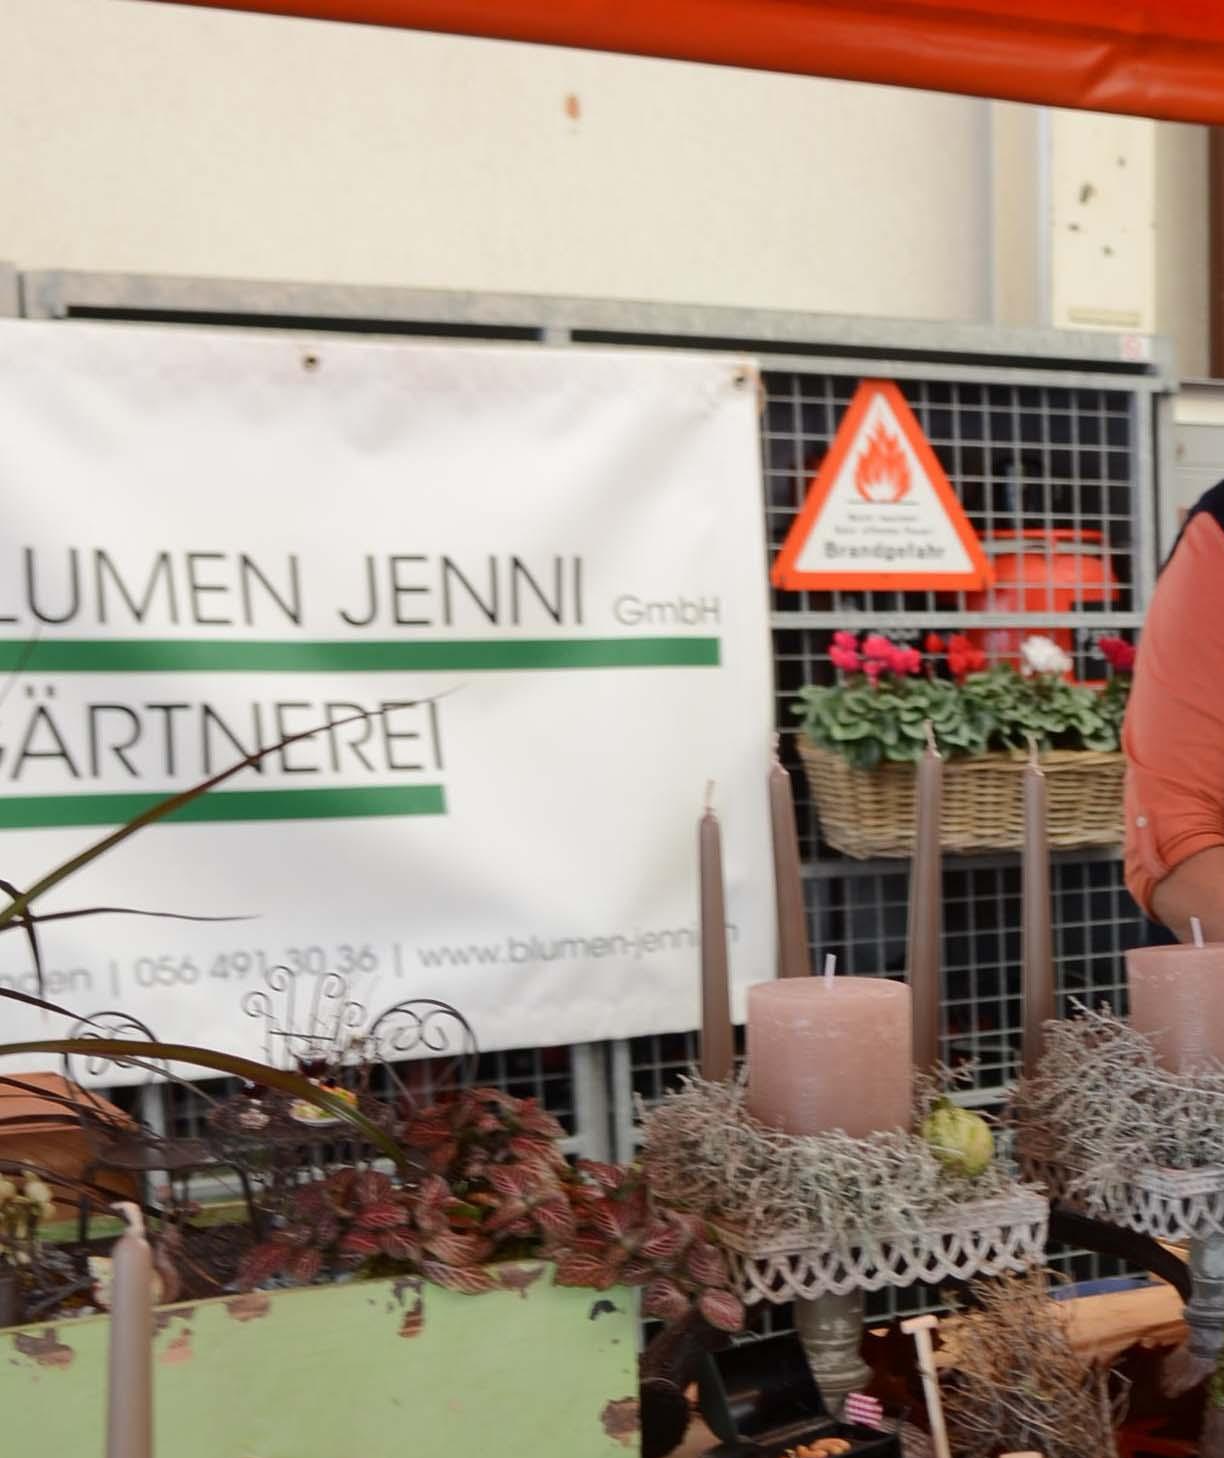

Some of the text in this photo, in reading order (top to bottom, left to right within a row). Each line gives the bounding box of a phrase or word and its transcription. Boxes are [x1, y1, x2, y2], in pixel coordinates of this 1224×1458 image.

[338, 554, 585, 628] JENNI
[612, 594, 722, 627] GmbH
[0, 684, 446, 781] ÄRTNEREI
[132, 956, 199, 989] 056
[208, 949, 267, 981] 491
[284, 945, 327, 978] 30
[336, 943, 379, 974] 36
